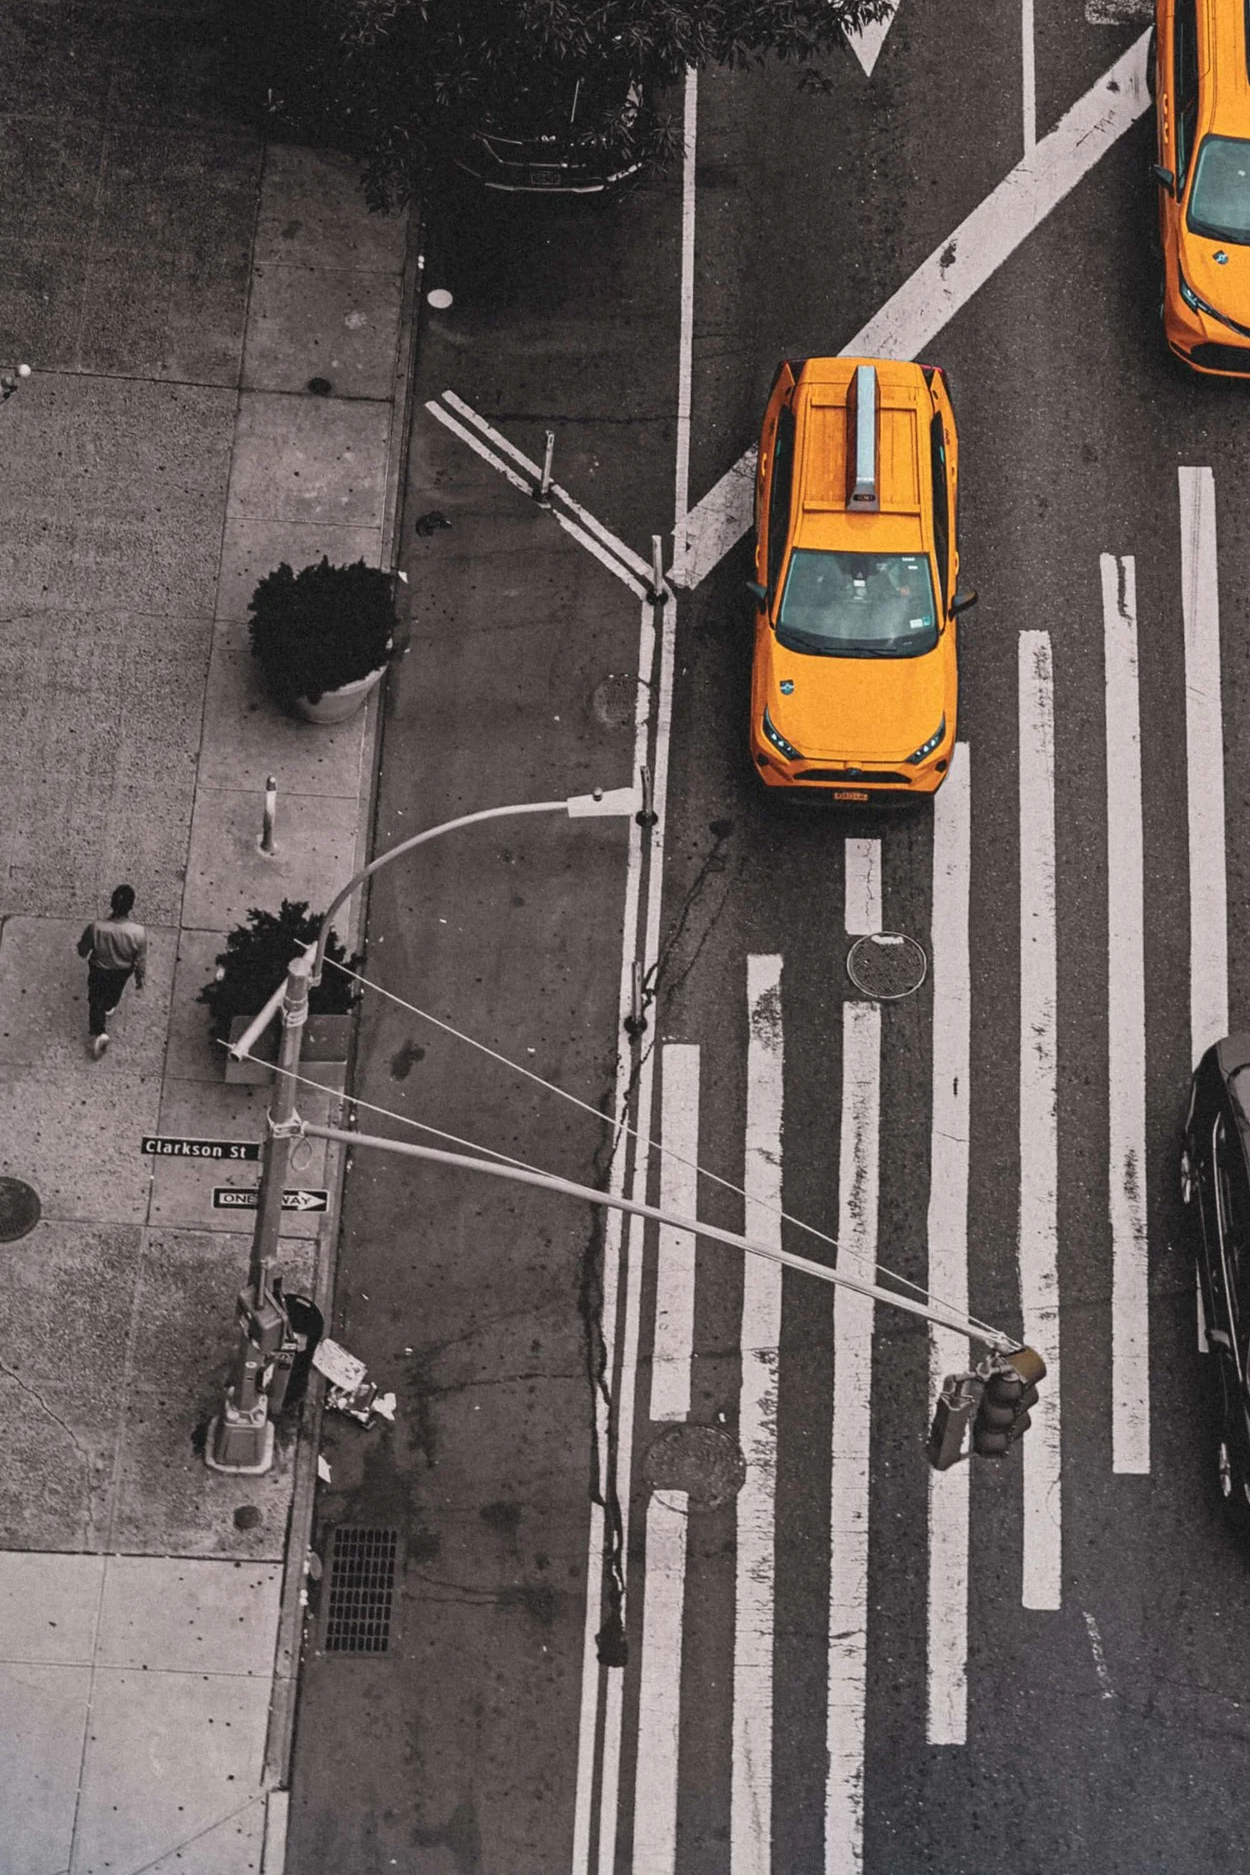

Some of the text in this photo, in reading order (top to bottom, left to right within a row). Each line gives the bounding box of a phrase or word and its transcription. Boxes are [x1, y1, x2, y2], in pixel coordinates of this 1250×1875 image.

[145, 1140, 247, 1159] Clarkson St
[223, 1192, 258, 1204] ONE
